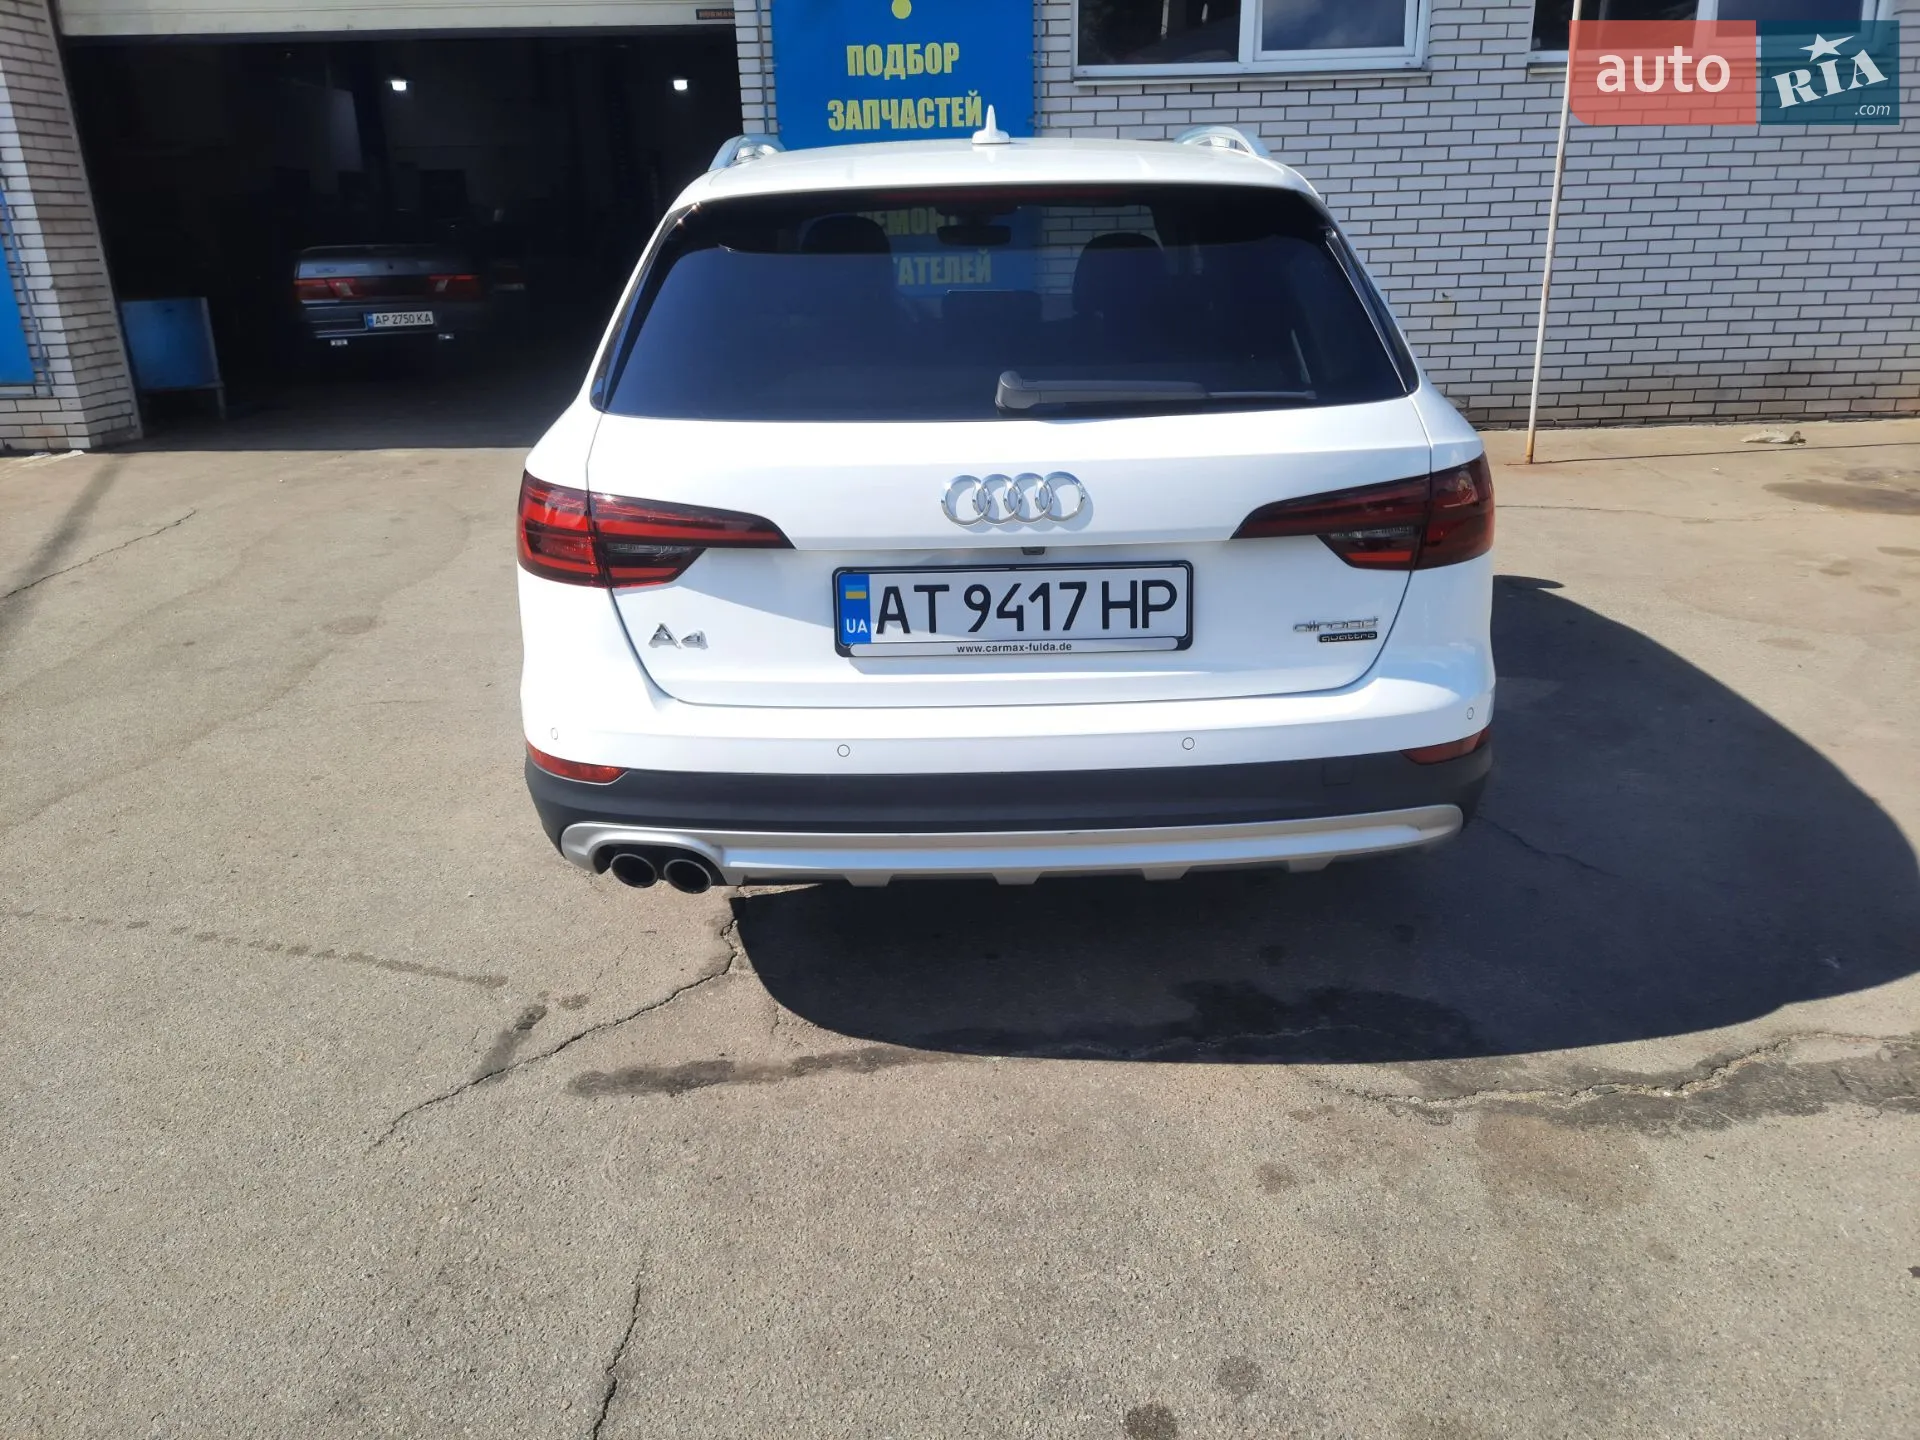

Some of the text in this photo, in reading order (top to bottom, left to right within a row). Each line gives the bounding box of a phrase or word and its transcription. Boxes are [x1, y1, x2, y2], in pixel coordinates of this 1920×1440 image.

[846, 42, 960, 81] ПОДБОР
[827, 90, 982, 131] ЗАПЧАСТЕЙ
[892, 248, 992, 286] АТЕЛЕЙ
[375, 313, 432, 325] AP 2750 KA
[876, 579, 1178, 634] AT 9417 HP
[846, 618, 868, 634] UA
[1293, 616, 1379, 633] allroad
[648, 622, 709, 650] A4
[1321, 632, 1376, 642] quattro
[956, 642, 1072, 653] www.carmax-fulda.de
